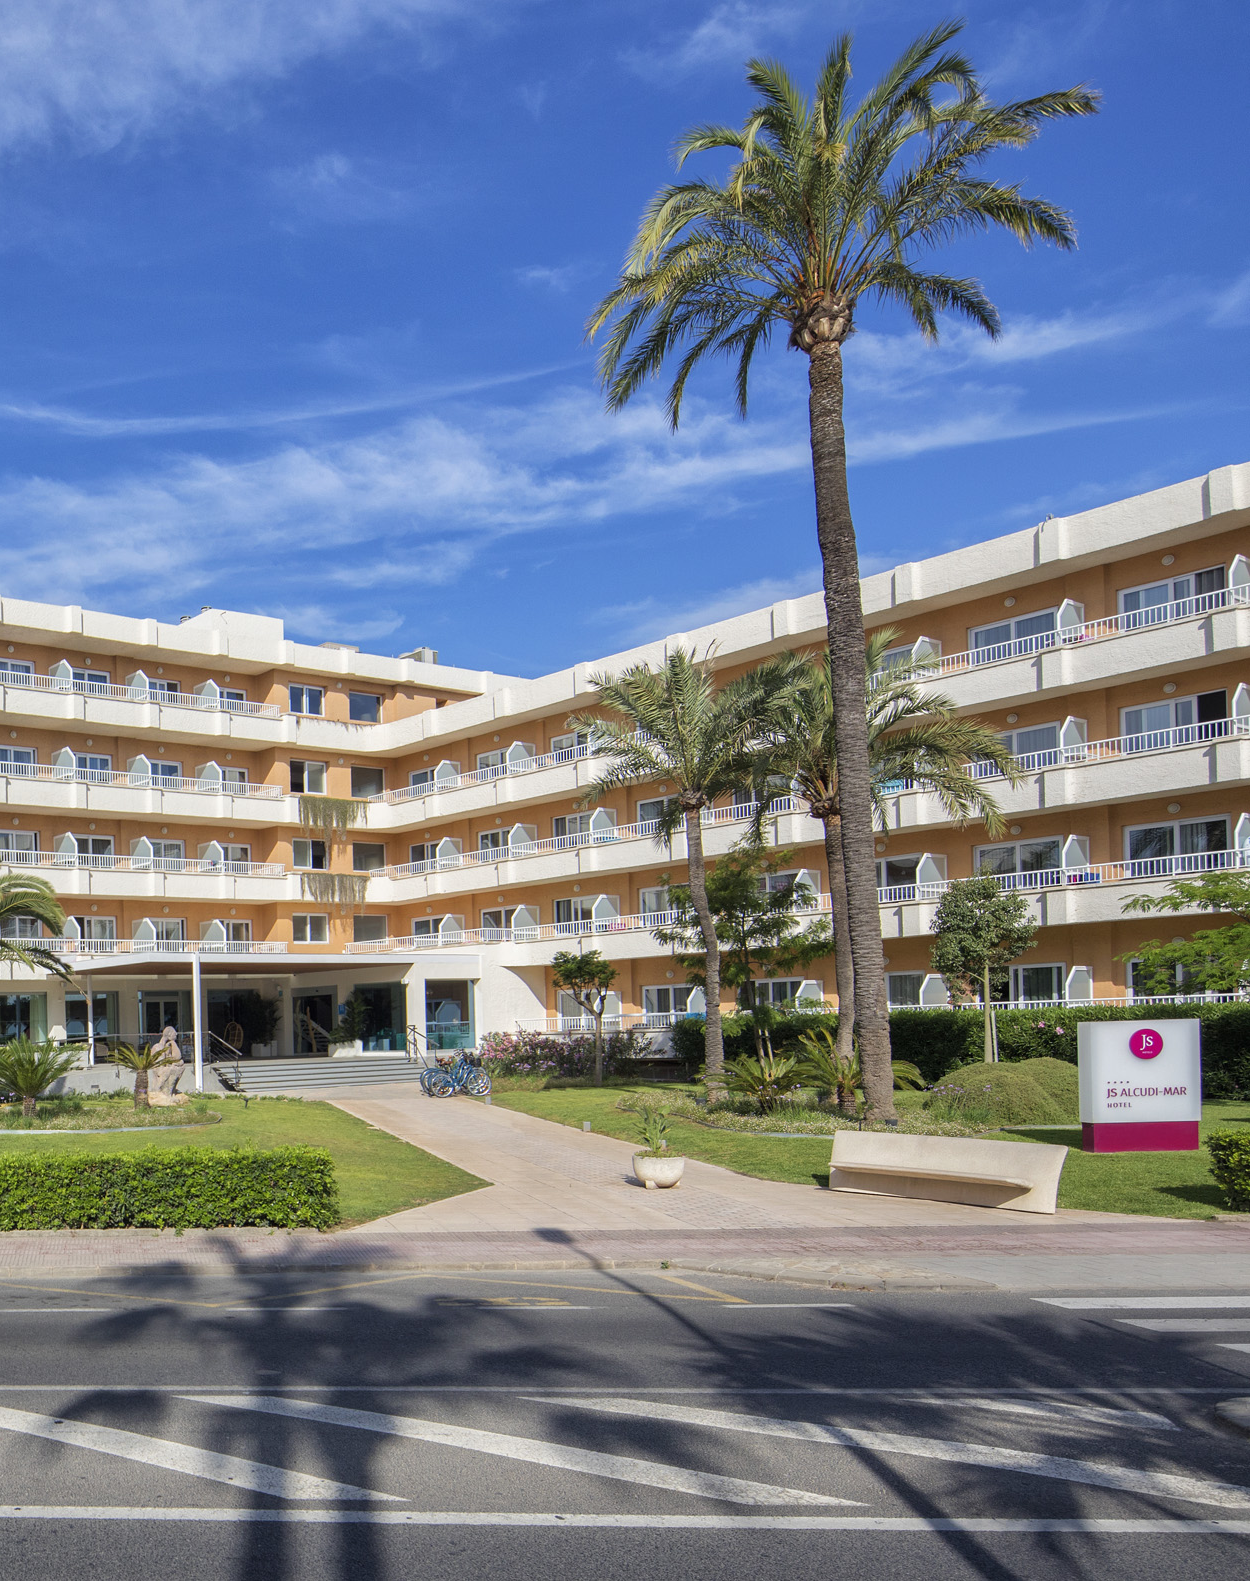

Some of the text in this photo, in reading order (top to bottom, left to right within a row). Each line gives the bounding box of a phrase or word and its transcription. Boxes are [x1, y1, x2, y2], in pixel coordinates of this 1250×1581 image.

[1106, 1086, 1187, 1099] JS ALCUDI-MAR
[1107, 1101, 1133, 1109] HOTEL
